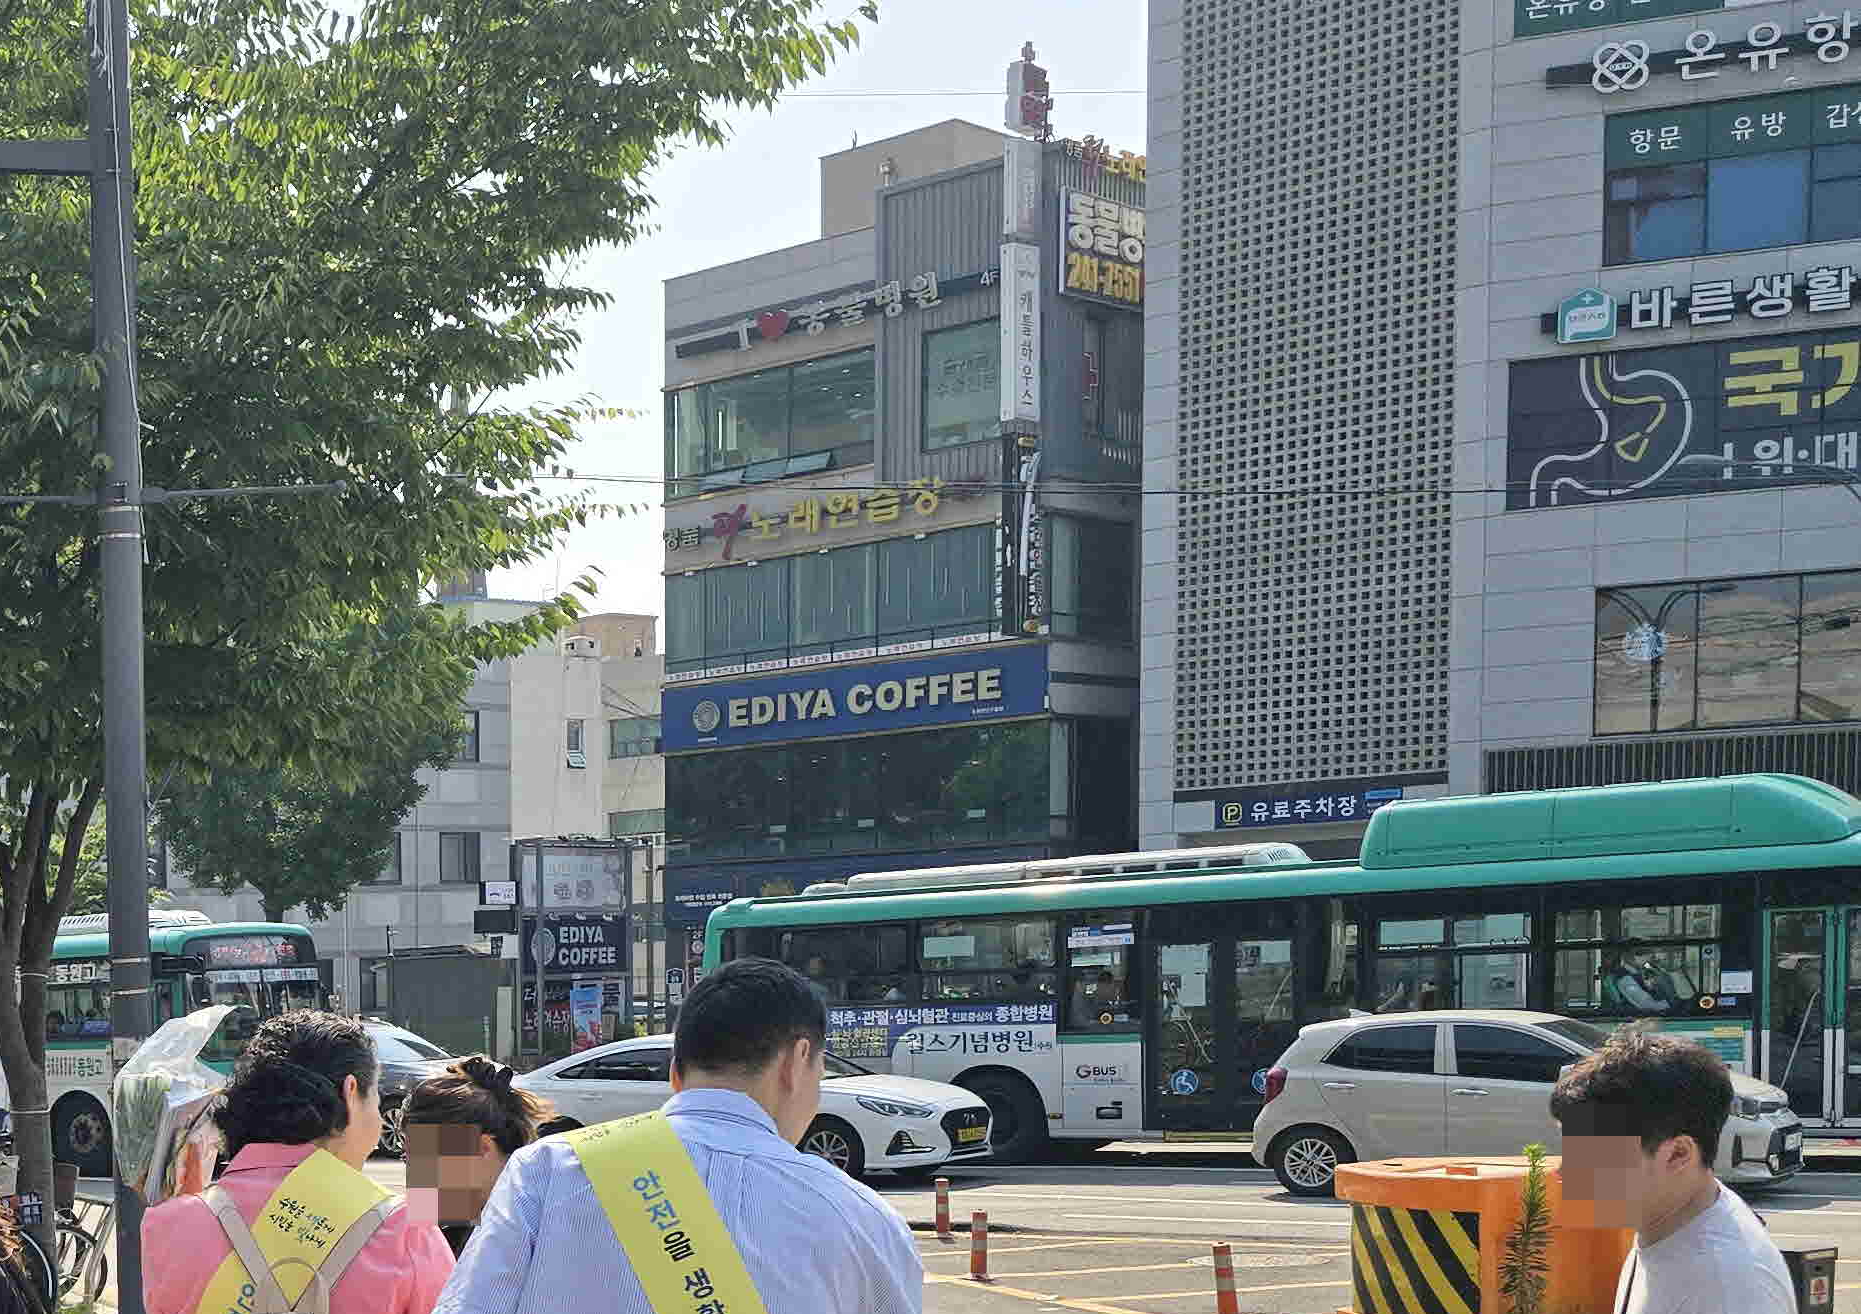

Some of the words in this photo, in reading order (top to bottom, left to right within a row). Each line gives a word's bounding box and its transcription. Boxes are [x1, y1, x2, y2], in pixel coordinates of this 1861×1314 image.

[1628, 126, 1683, 154] 항문
[1730, 112, 1787, 142] 유방
[1629, 265, 1857, 330] 바른생활
[747, 476, 945, 540] 노래연습장
[728, 688, 837, 728] EDIYA
[846, 667, 1004, 716] COFFEE
[1250, 795, 1357, 822] 유료주차장
[558, 926, 604, 944] EDIYA
[557, 947, 618, 966] COFFEE
[995, 1004, 1054, 1023] 종합병원
[632, 1169, 695, 1263] 안전을
